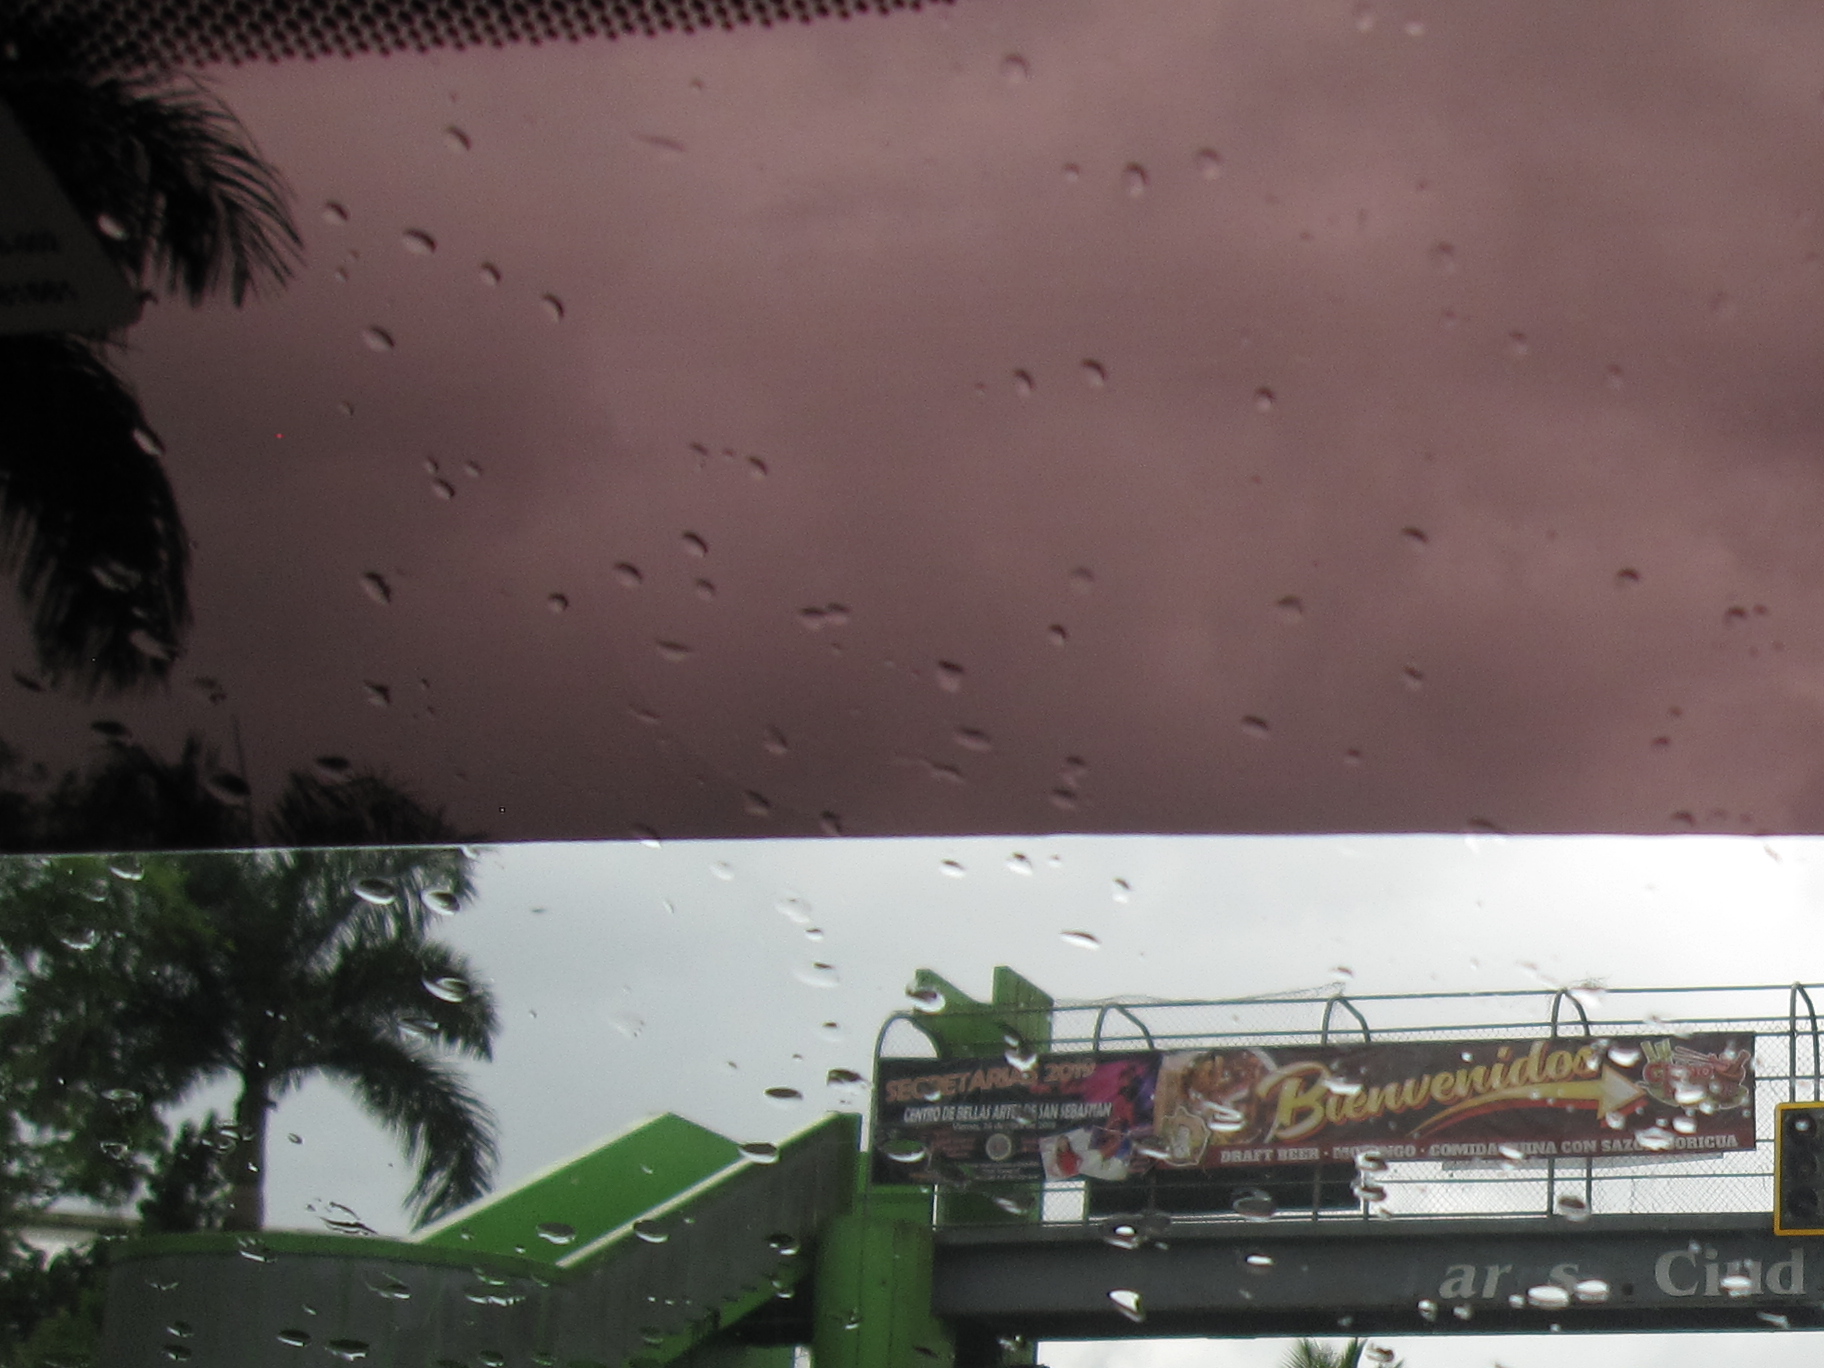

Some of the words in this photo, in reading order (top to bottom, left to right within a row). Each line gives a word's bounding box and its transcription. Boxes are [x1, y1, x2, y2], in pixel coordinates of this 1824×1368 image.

[1256, 1040, 1601, 1141] Bienvenidos
[904, 1106, 941, 1123] CENTRO
[956, 1105, 991, 1120] BELLAS
[1221, 1149, 1272, 1163] DRAFT
[1278, 1148, 1320, 1162] BEER
[1430, 1143, 1497, 1157] COMIDA
[1561, 1140, 1597, 1153] CON
